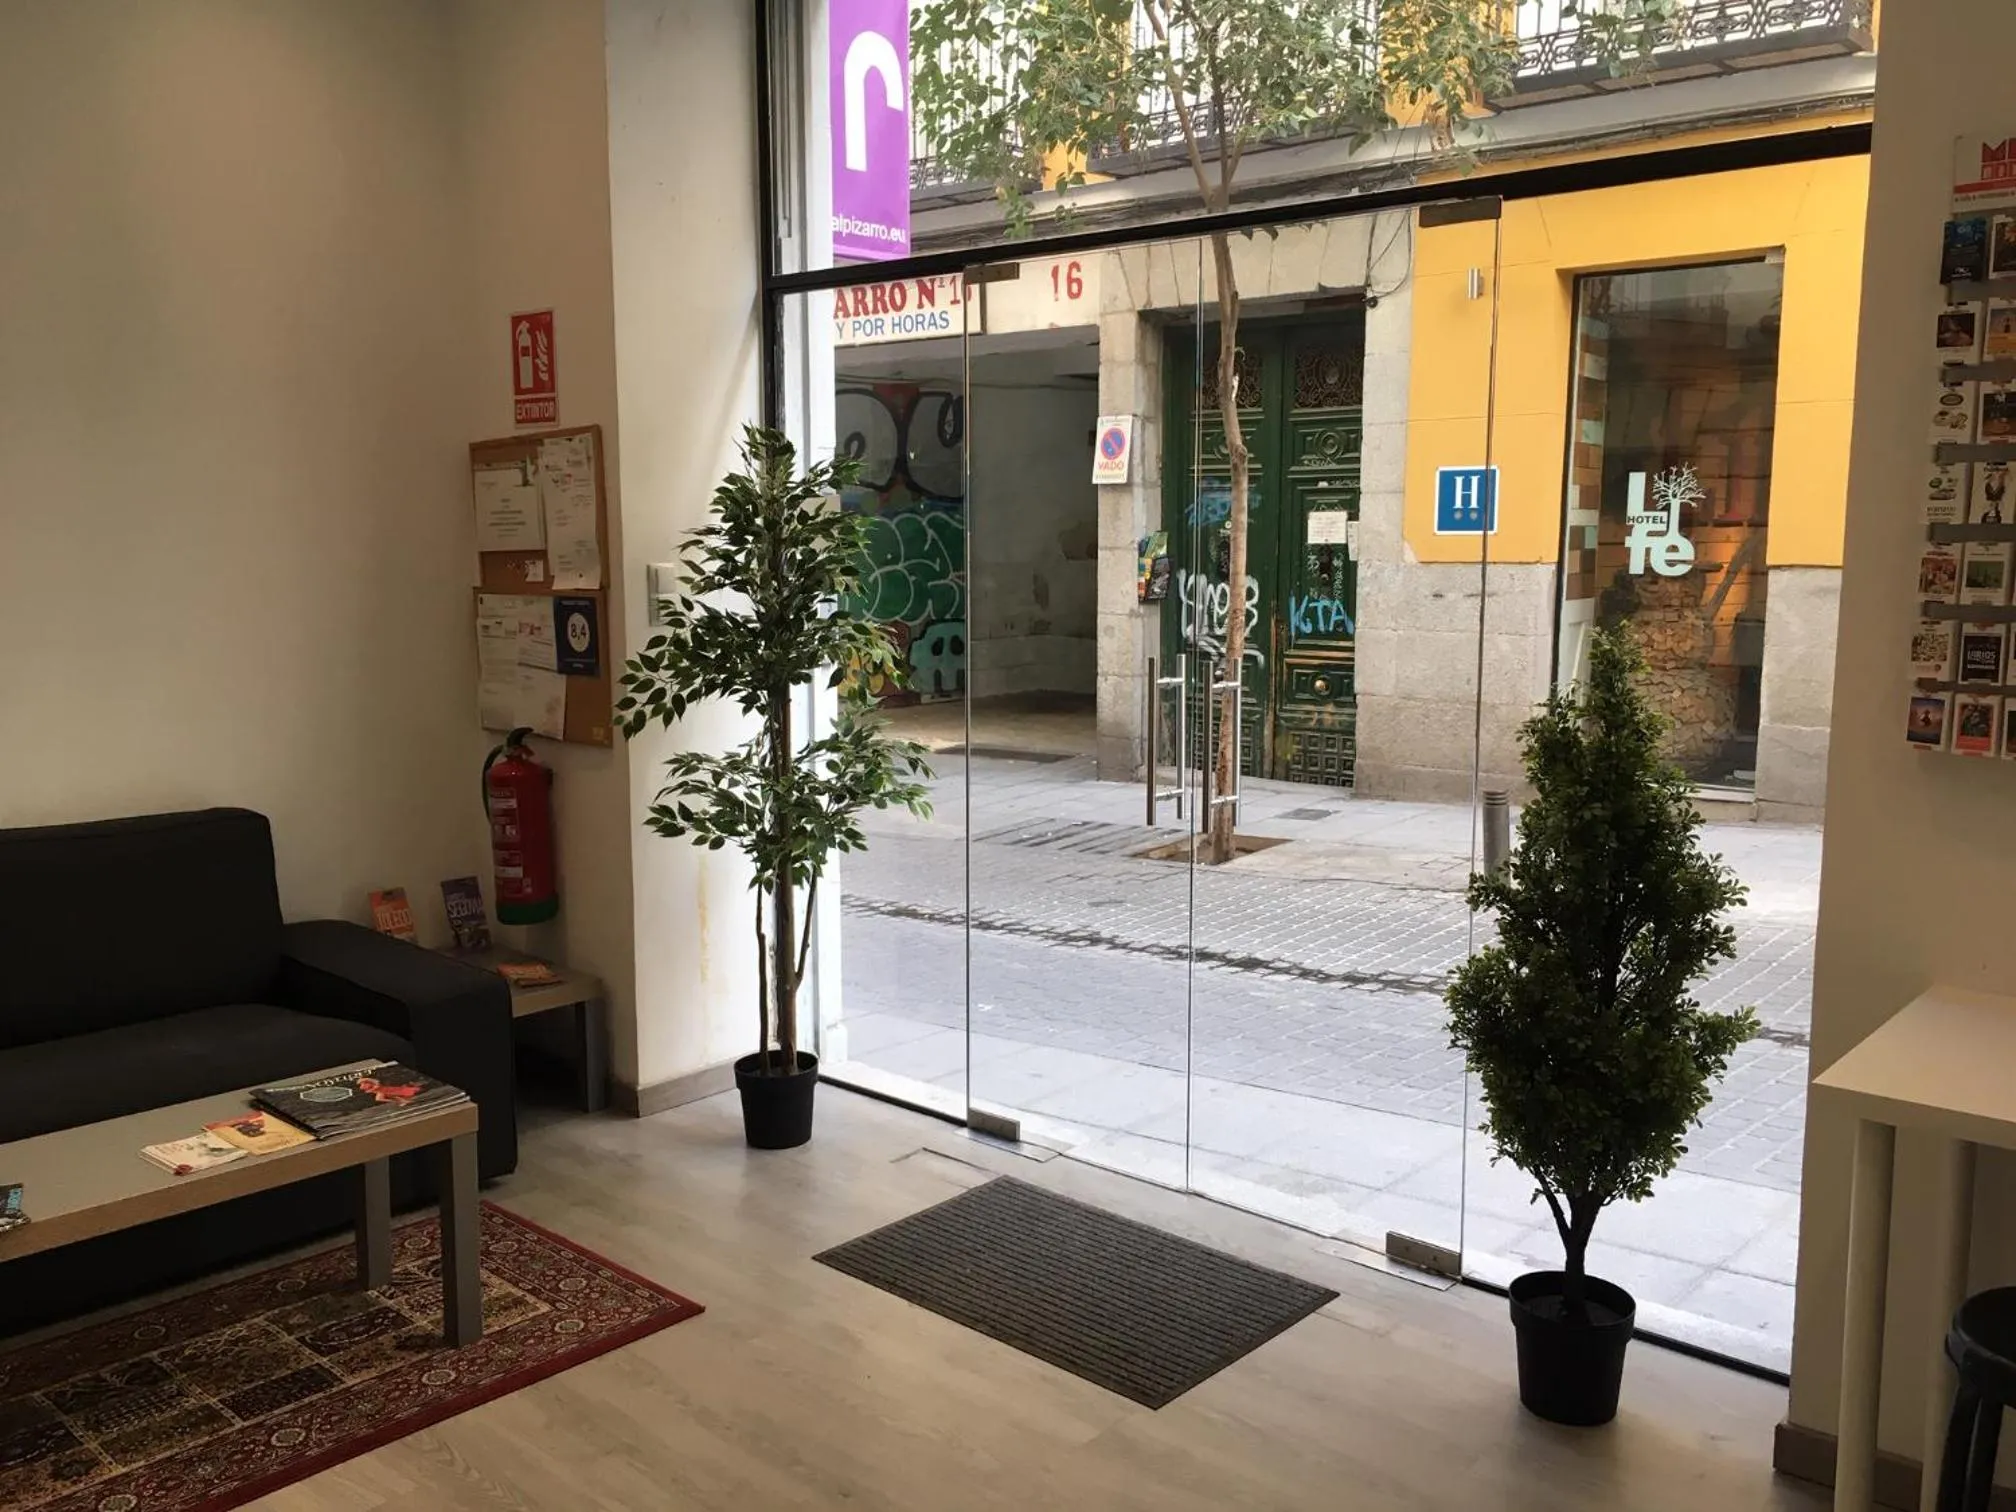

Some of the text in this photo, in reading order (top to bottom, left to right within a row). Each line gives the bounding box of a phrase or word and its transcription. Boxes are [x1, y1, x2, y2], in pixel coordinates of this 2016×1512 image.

[831, 214, 906, 243] alpizarro.eu
[1050, 260, 1083, 302] 16
[835, 310, 950, 339] Y POR HORAS
[516, 397, 555, 420] EXTINTOR
[1098, 460, 1124, 471] VADO
[1453, 475, 1481, 509] H
[1627, 515, 1666, 524] HOTEL
[571, 623, 587, 641] 8,4
